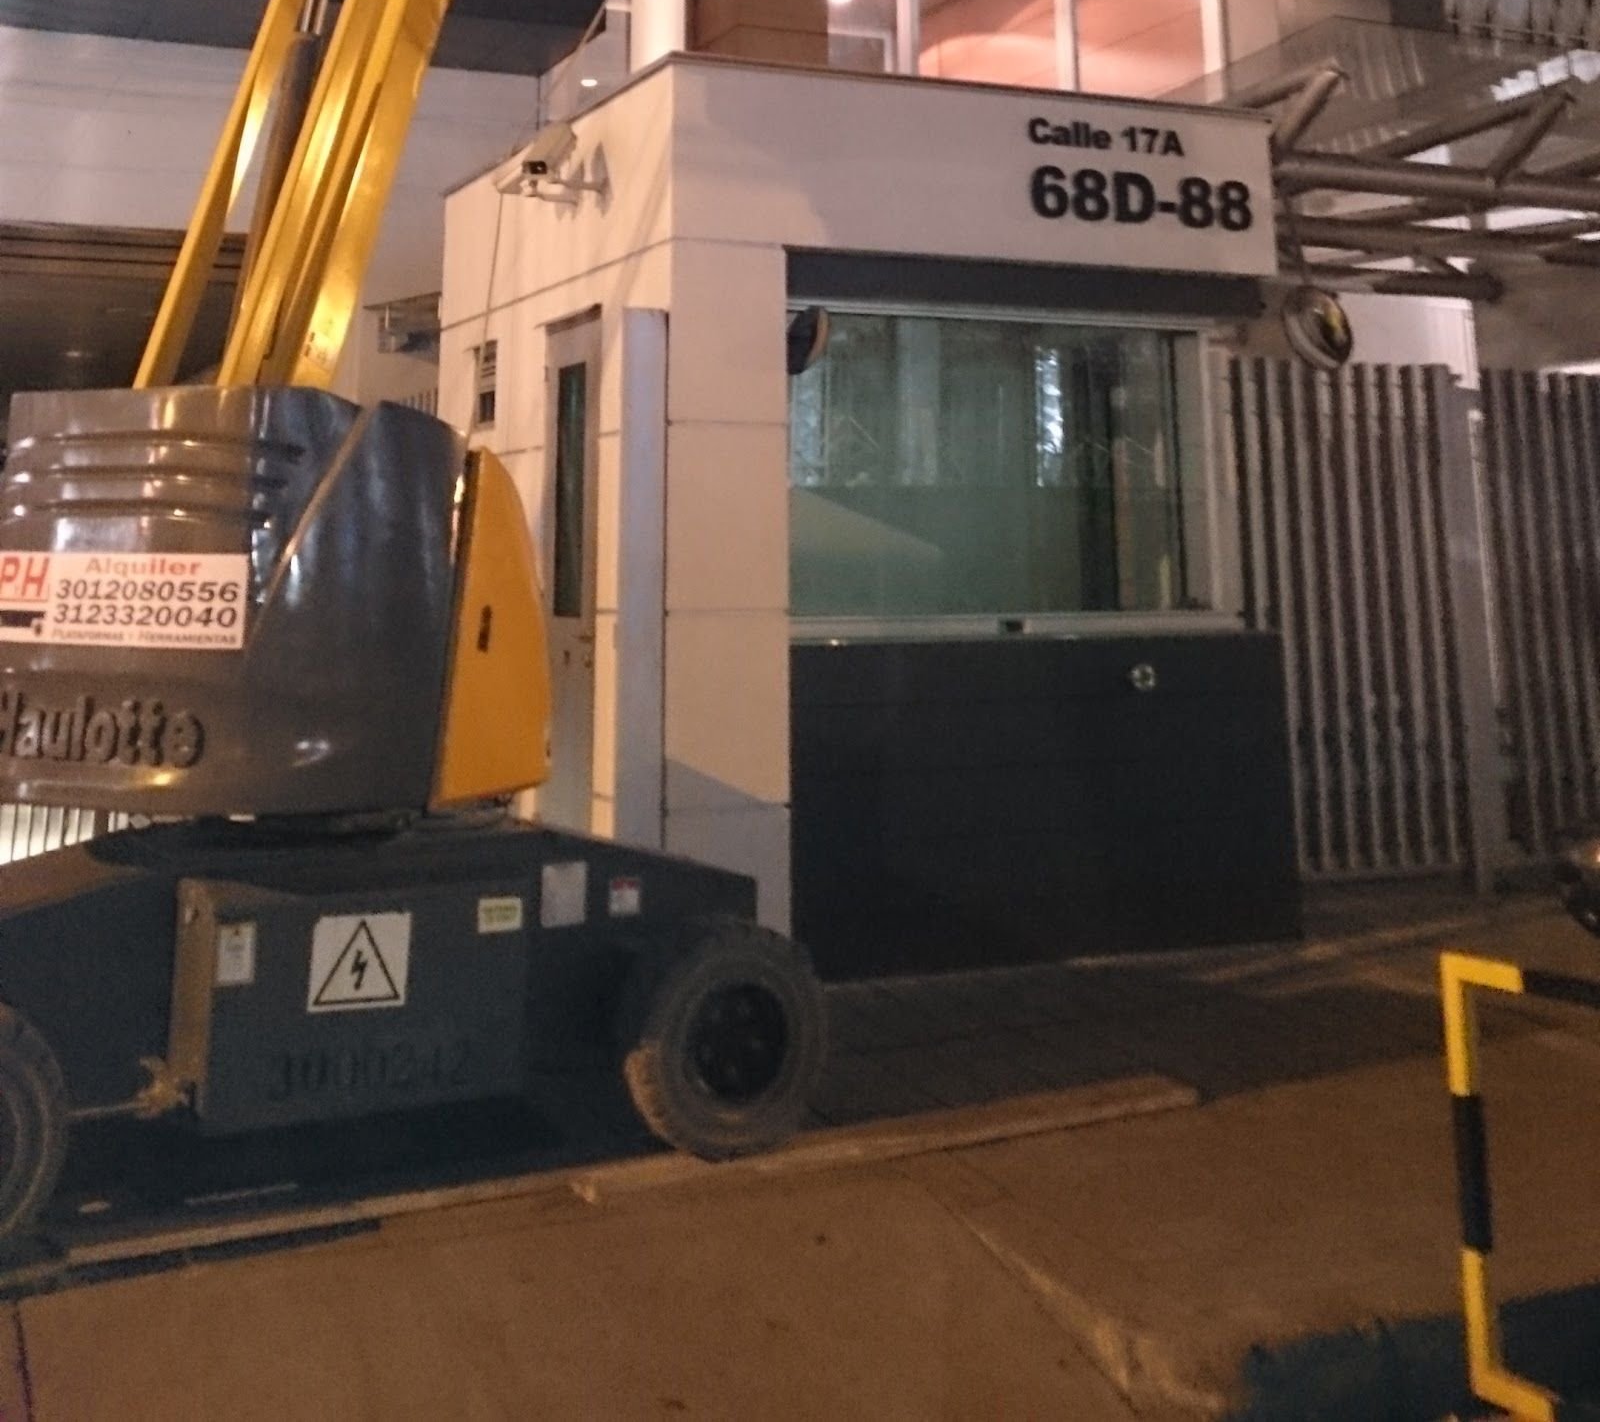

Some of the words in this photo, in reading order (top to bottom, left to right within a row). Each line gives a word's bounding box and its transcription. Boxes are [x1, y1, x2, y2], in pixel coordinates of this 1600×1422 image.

[1028, 117, 1111, 149] Calle
[1120, 126, 1184, 157] 17A
[1031, 165, 1252, 231] 68D-88
[85, 557, 201, 576] Alquiler
[55, 579, 240, 603] 3012080556
[53, 603, 237, 628] 3123320040
